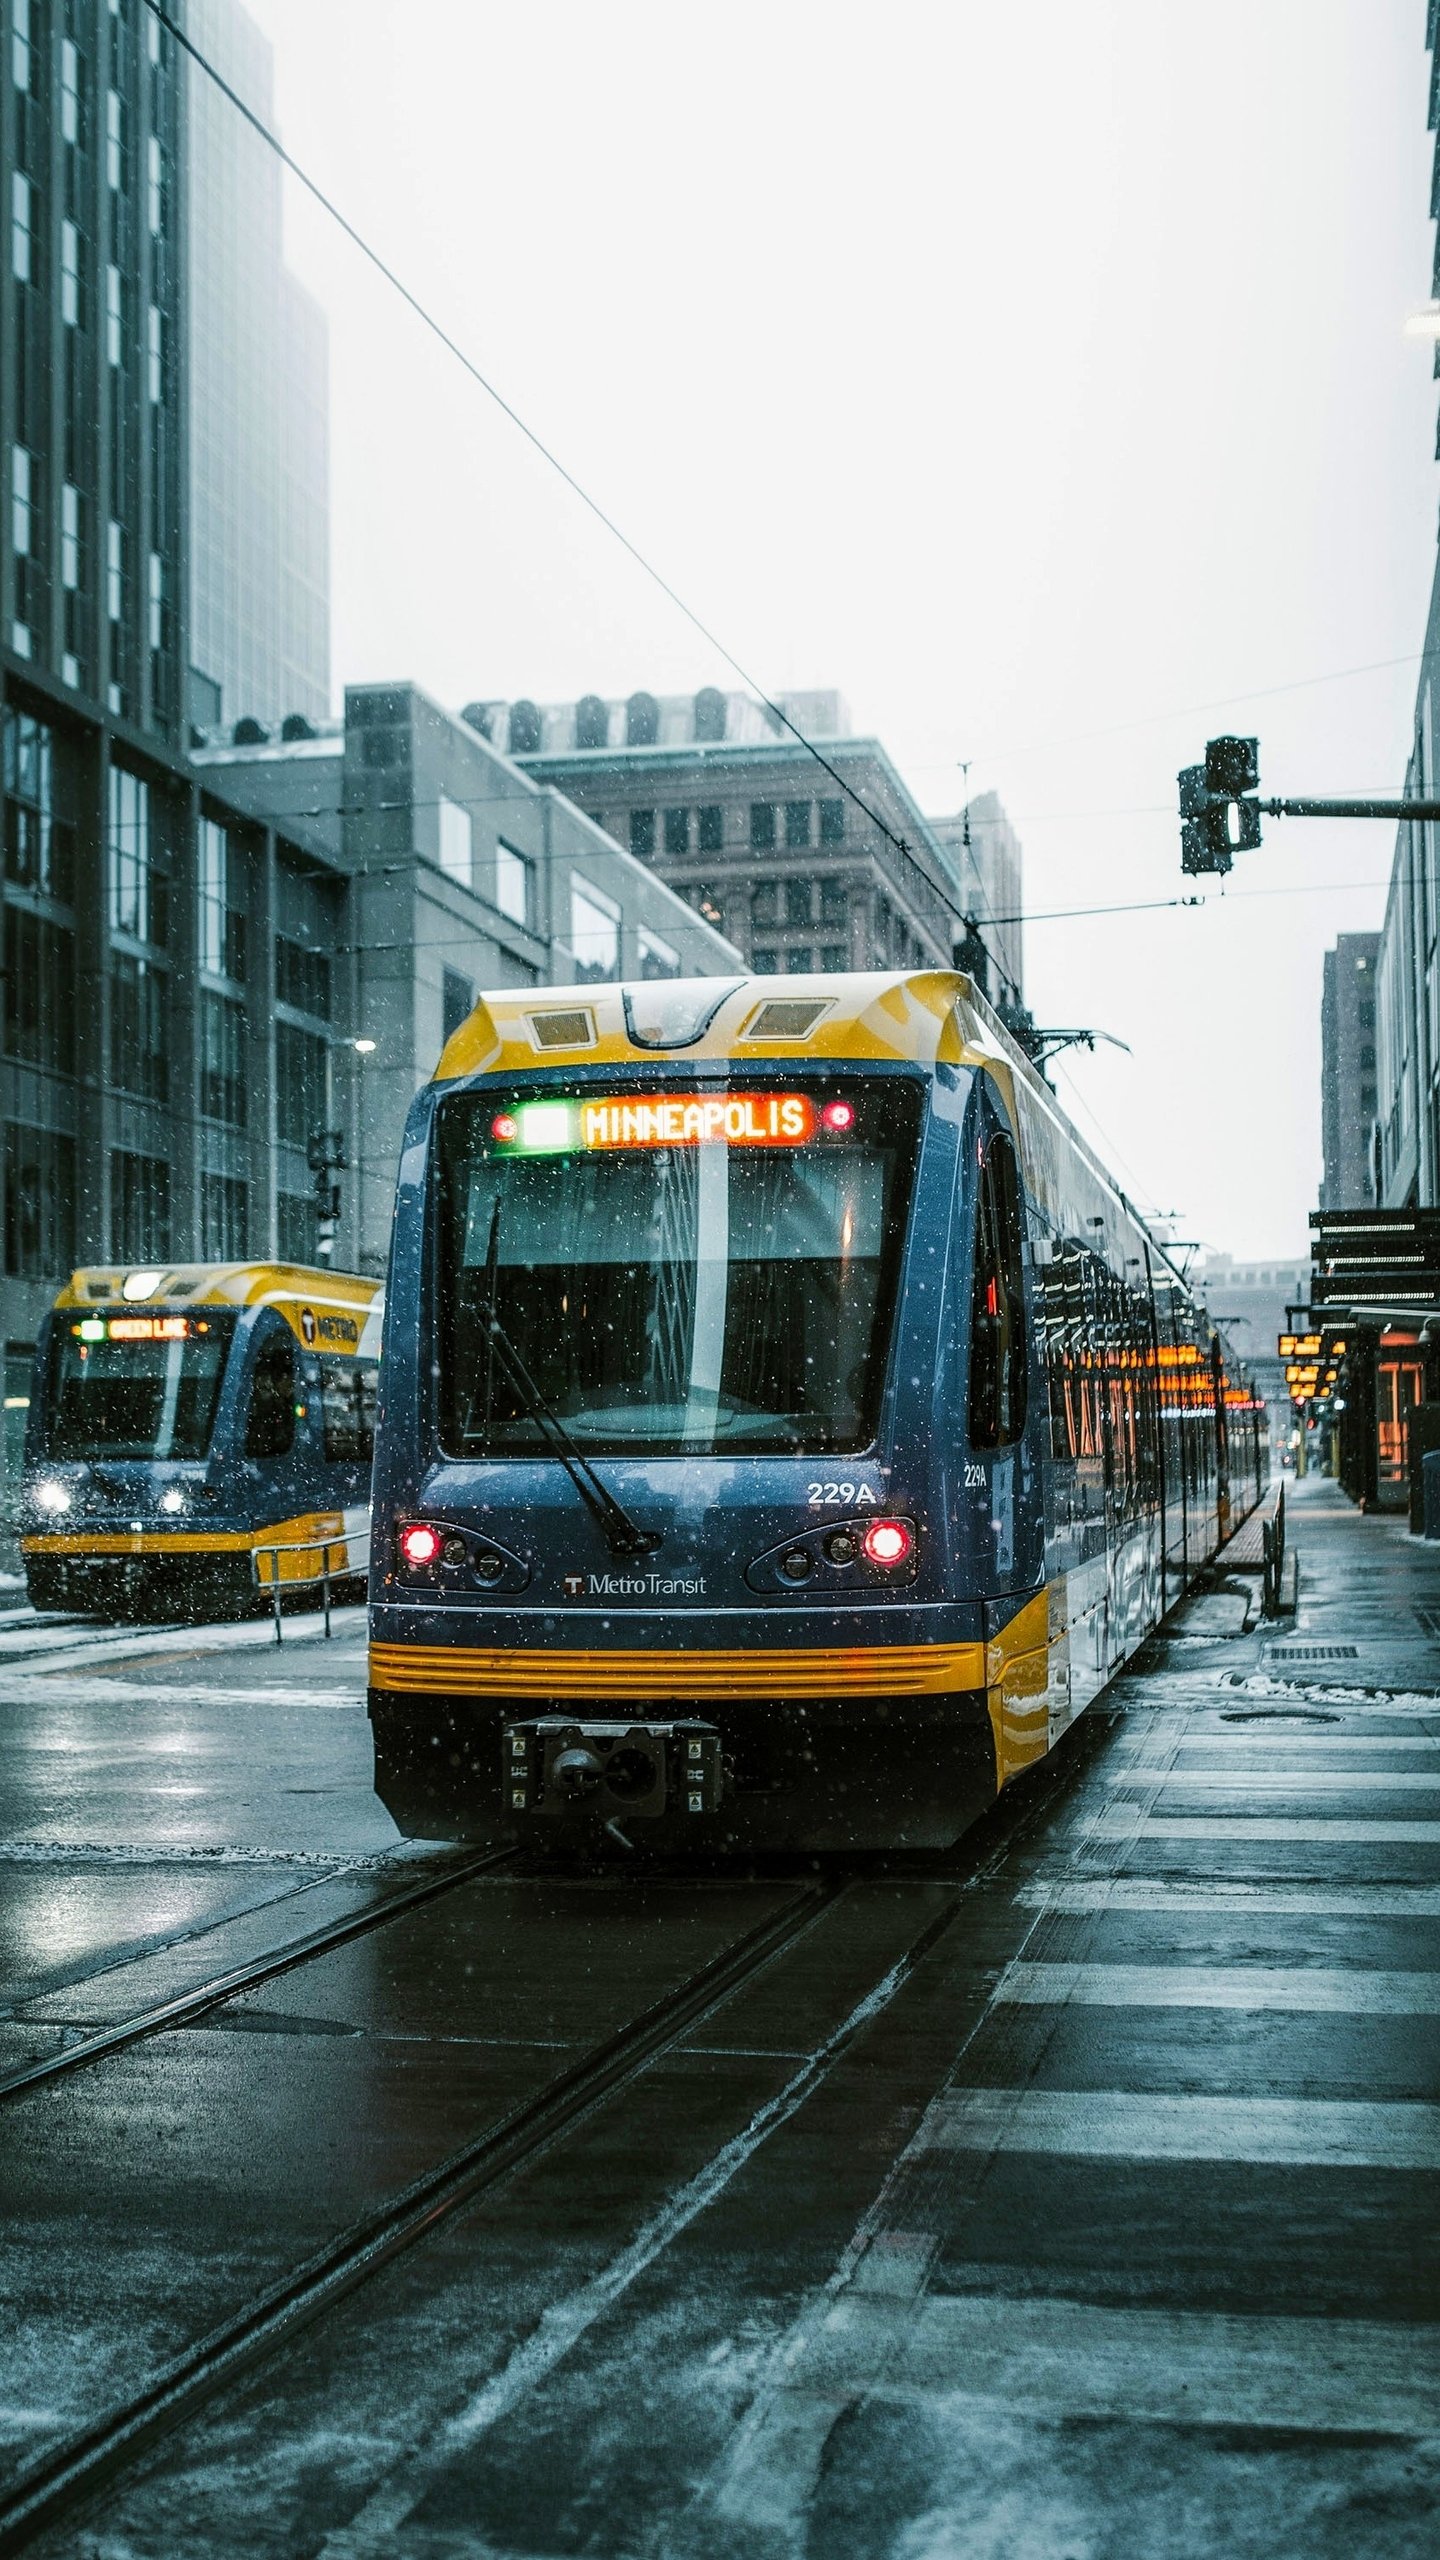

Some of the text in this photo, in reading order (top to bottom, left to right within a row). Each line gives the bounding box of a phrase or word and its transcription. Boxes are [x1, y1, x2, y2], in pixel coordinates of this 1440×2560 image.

[586, 1100, 803, 1142] MINNEAPOLIS
[963, 1465, 987, 1487] 229A
[807, 1483, 877, 1504] 229A
